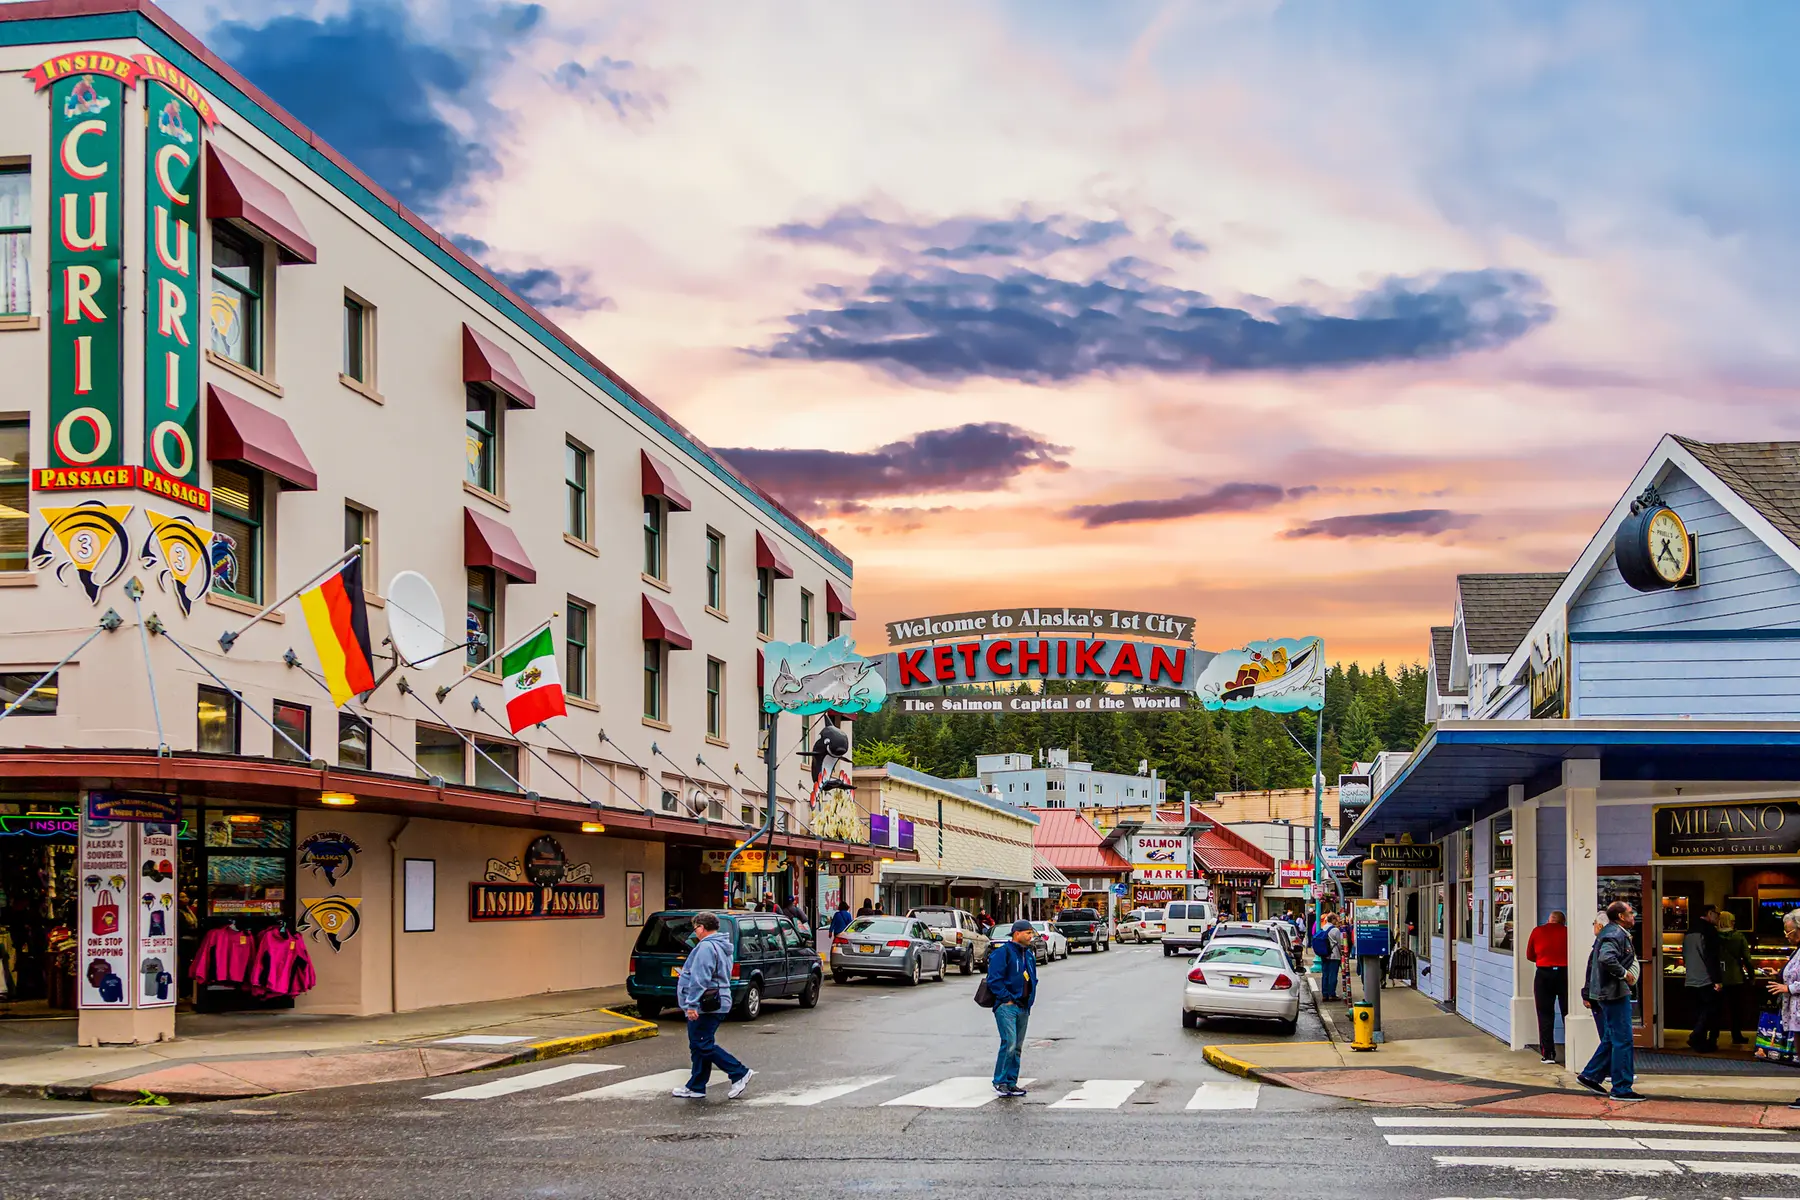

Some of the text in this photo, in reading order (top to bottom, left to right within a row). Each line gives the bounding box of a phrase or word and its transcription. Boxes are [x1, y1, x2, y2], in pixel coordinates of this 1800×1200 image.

[42, 54, 132, 79] INSIDE
[144, 55, 211, 117] INSIDE
[53, 119, 112, 467] CURIO
[150, 144, 193, 480] CURIO
[40, 469, 130, 488] PASSAGE
[143, 469, 208, 509] PASSAGE
[77, 533, 93, 560] 3
[174, 546, 186, 572] 3
[893, 608, 1187, 641] Welcome to Alaska's 1st City
[897, 639, 1187, 686] KETCHIKAN
[1533, 656, 1562, 710] MILANO
[903, 696, 1181, 712] The Salmon Capital of the World
[30, 821, 79, 831] INSIDE
[1670, 805, 1785, 835] MILANO
[86, 840, 124, 849] ALASKA'S
[144, 836, 173, 847] BASEBALL
[1139, 839, 1182, 849] SALMON
[1672, 843, 1784, 854] DIAMOND GALLERY
[87, 851, 124, 860] SOUVENIR
[151, 848, 167, 857] HATS
[1380, 847, 1433, 859] MILANO
[831, 863, 871, 874] TOURS
[1143, 869, 1206, 879] MARKET
[477, 887, 599, 915] INSIDE PASSAGE
[1136, 890, 1173, 901] SALMON
[327, 913, 337, 927] 3
[87, 937, 123, 946] ONE STOP
[87, 948, 124, 957] SHOPPING
